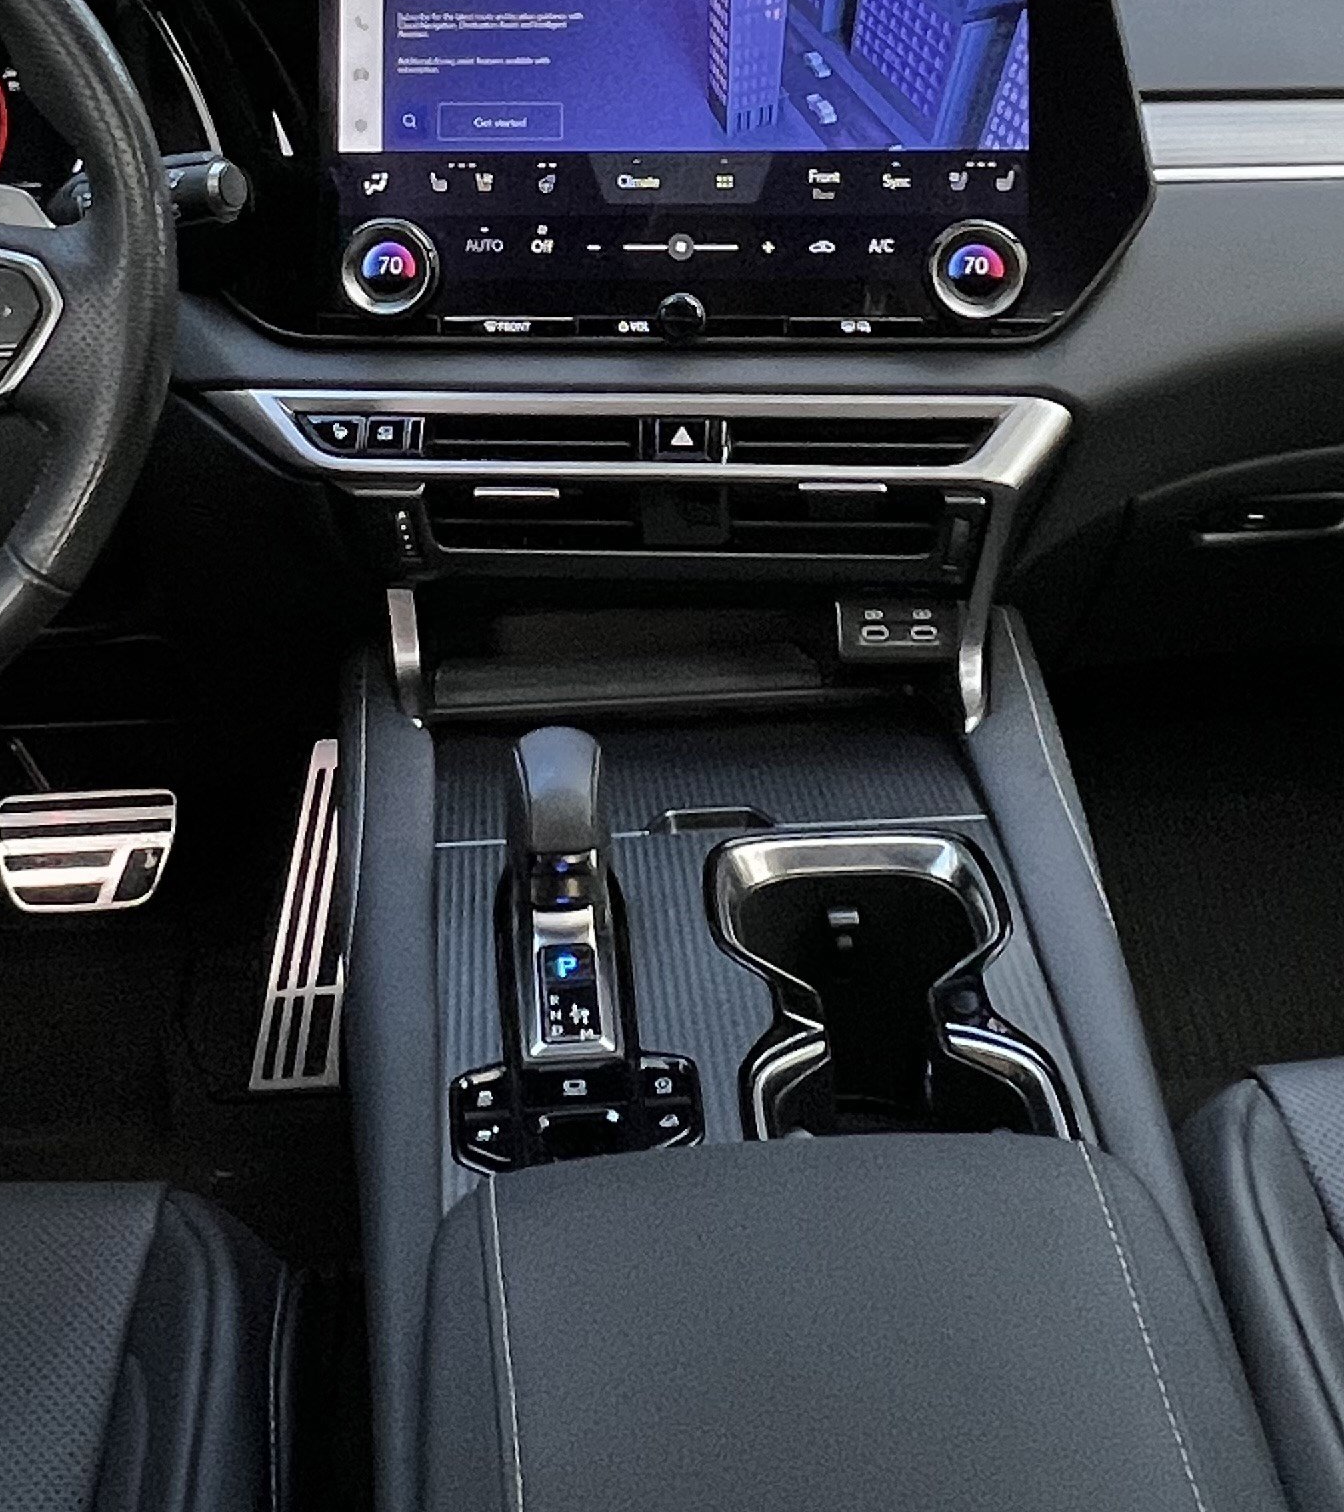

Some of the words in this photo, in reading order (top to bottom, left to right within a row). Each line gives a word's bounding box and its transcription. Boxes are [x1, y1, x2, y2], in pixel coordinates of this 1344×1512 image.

[473, 116, 492, 129] Get
[494, 116, 528, 128] started
[808, 168, 842, 185] Front
[882, 172, 912, 191] Sync
[465, 238, 504, 253] AUTO
[530, 238, 555, 254] Off
[868, 238, 896, 254] A/C
[378, 256, 404, 276] 70
[964, 256, 990, 276] 70
[556, 955, 579, 978] P
[551, 1024, 564, 1036] D
[580, 1028, 595, 1041] M
